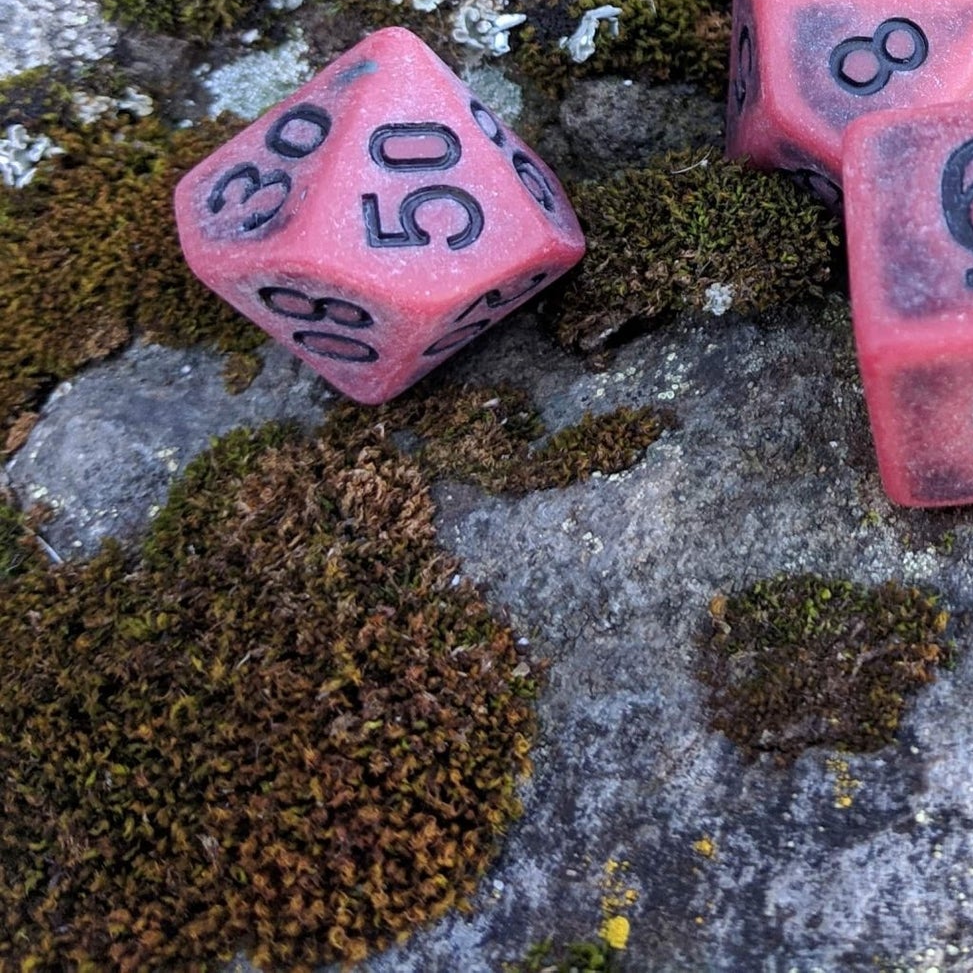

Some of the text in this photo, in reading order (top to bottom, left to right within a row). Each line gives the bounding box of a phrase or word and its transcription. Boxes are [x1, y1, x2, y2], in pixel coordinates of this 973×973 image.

[830, 17, 929, 95] 8
[206, 103, 332, 232] 30
[361, 122, 485, 250] 50
[257, 286, 379, 363] 80
